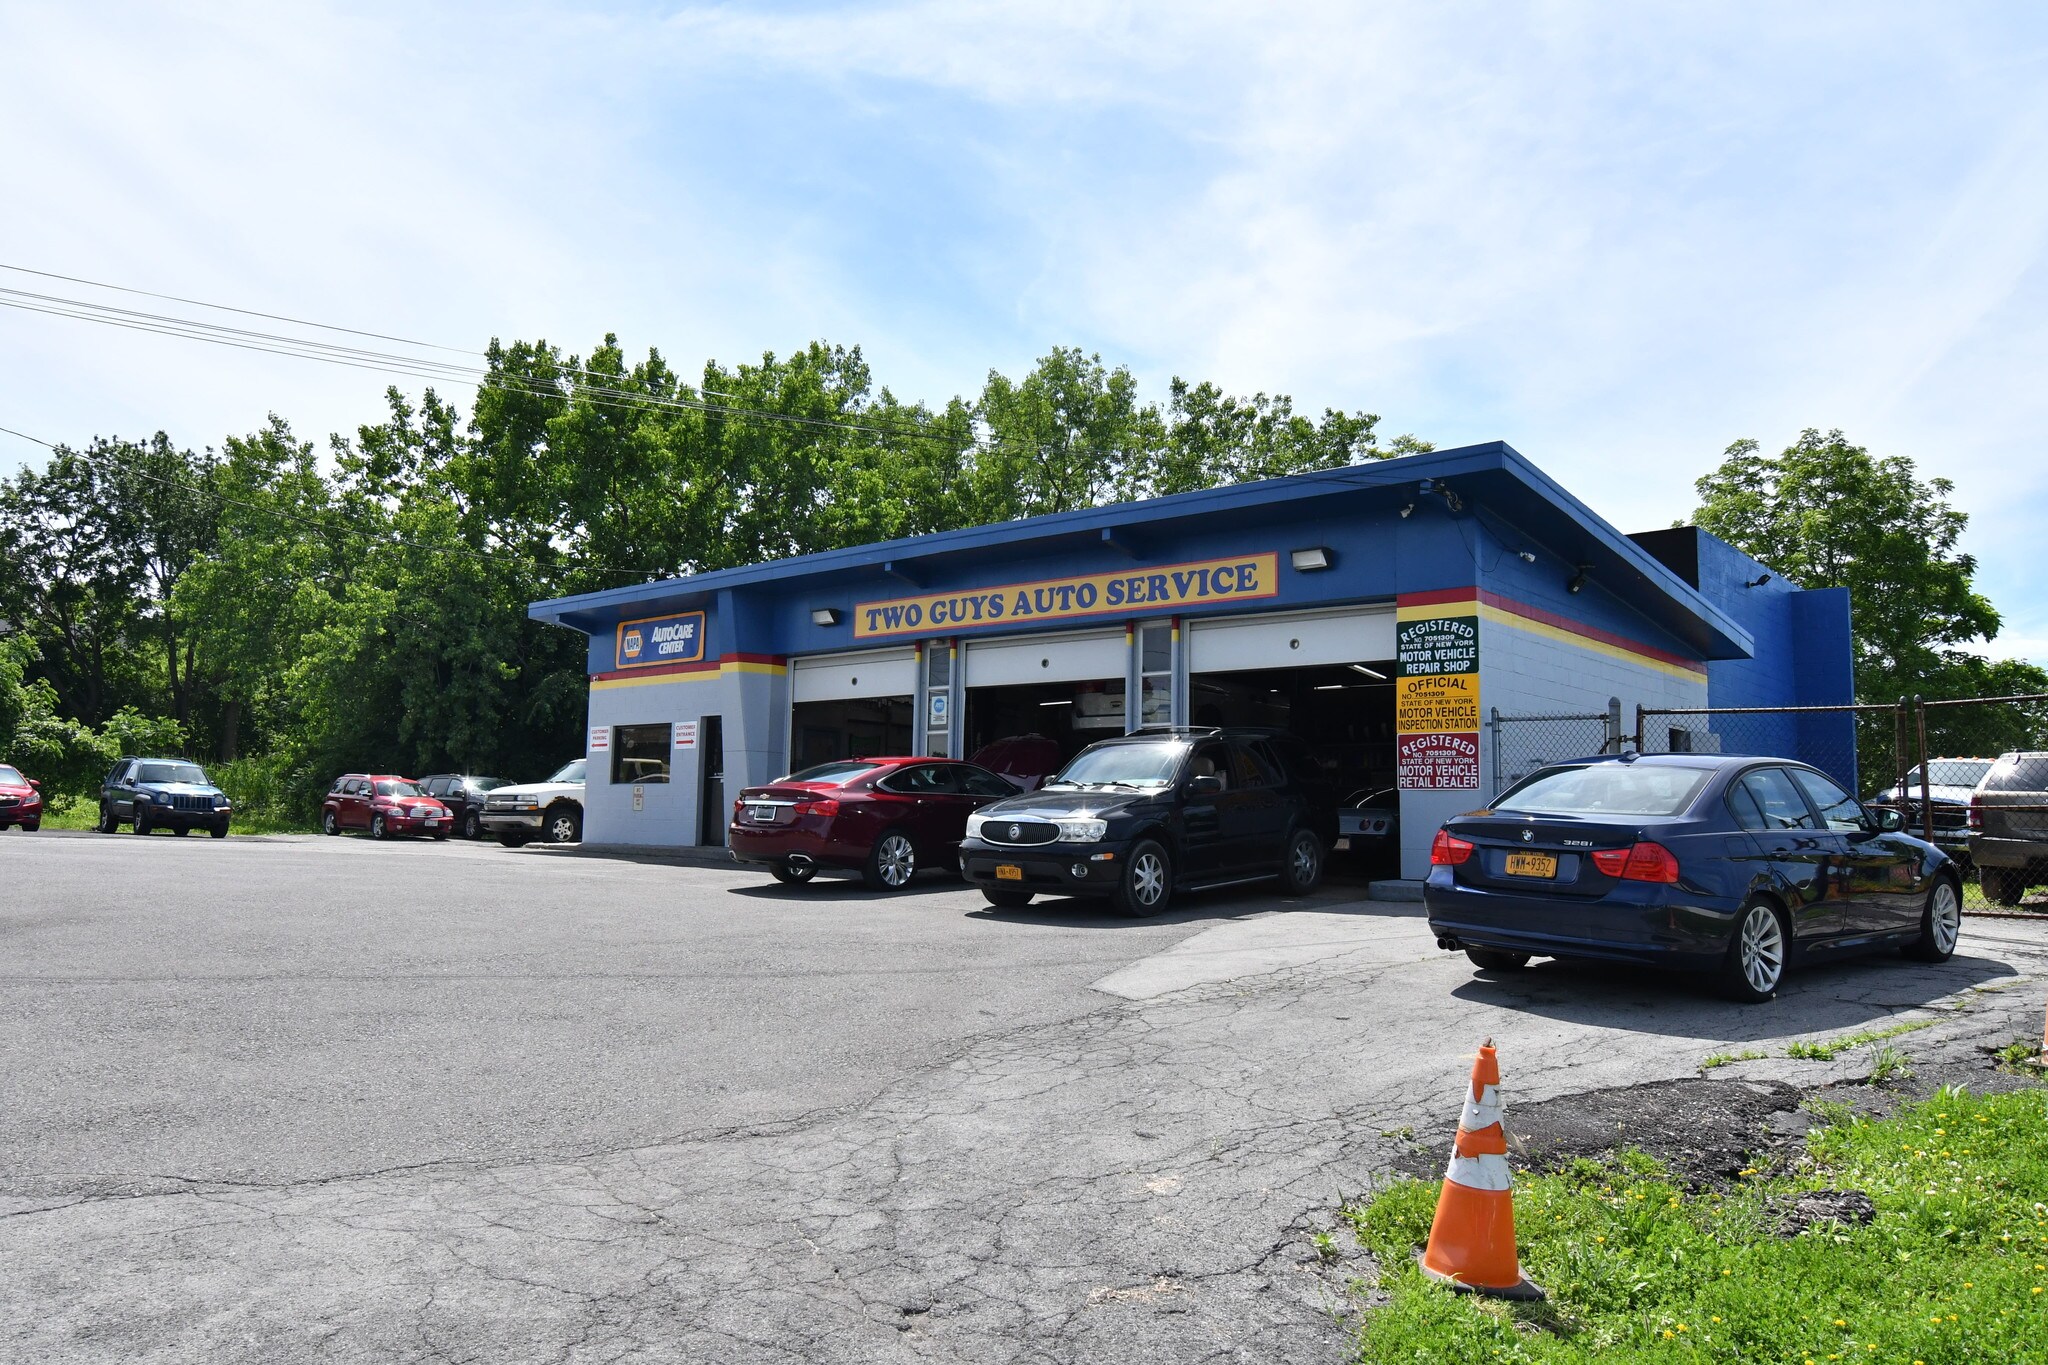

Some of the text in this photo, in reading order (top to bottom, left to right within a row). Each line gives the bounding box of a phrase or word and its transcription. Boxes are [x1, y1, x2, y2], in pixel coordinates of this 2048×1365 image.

[866, 563, 1258, 631] TWO GUYS AUTO SERVICE
[1400, 620, 1473, 643] REGISTERED
[626, 637, 640, 651] NAPA
[659, 640, 684, 655] CENTER
[1400, 647, 1475, 662] MOTOR VEHICLE
[1407, 661, 1470, 674] REPAIR SHOP
[1408, 677, 1467, 692] OFFICIAL
[1400, 706, 1476, 718] MOTOR VEHICLE
[1399, 718, 1477, 730] INSPECTION STATION
[1402, 735, 1475, 756] REGISTERED
[1400, 765, 1477, 776] MOTOR VEHICLE
[1400, 777, 1478, 787] RETAIL DEALER
